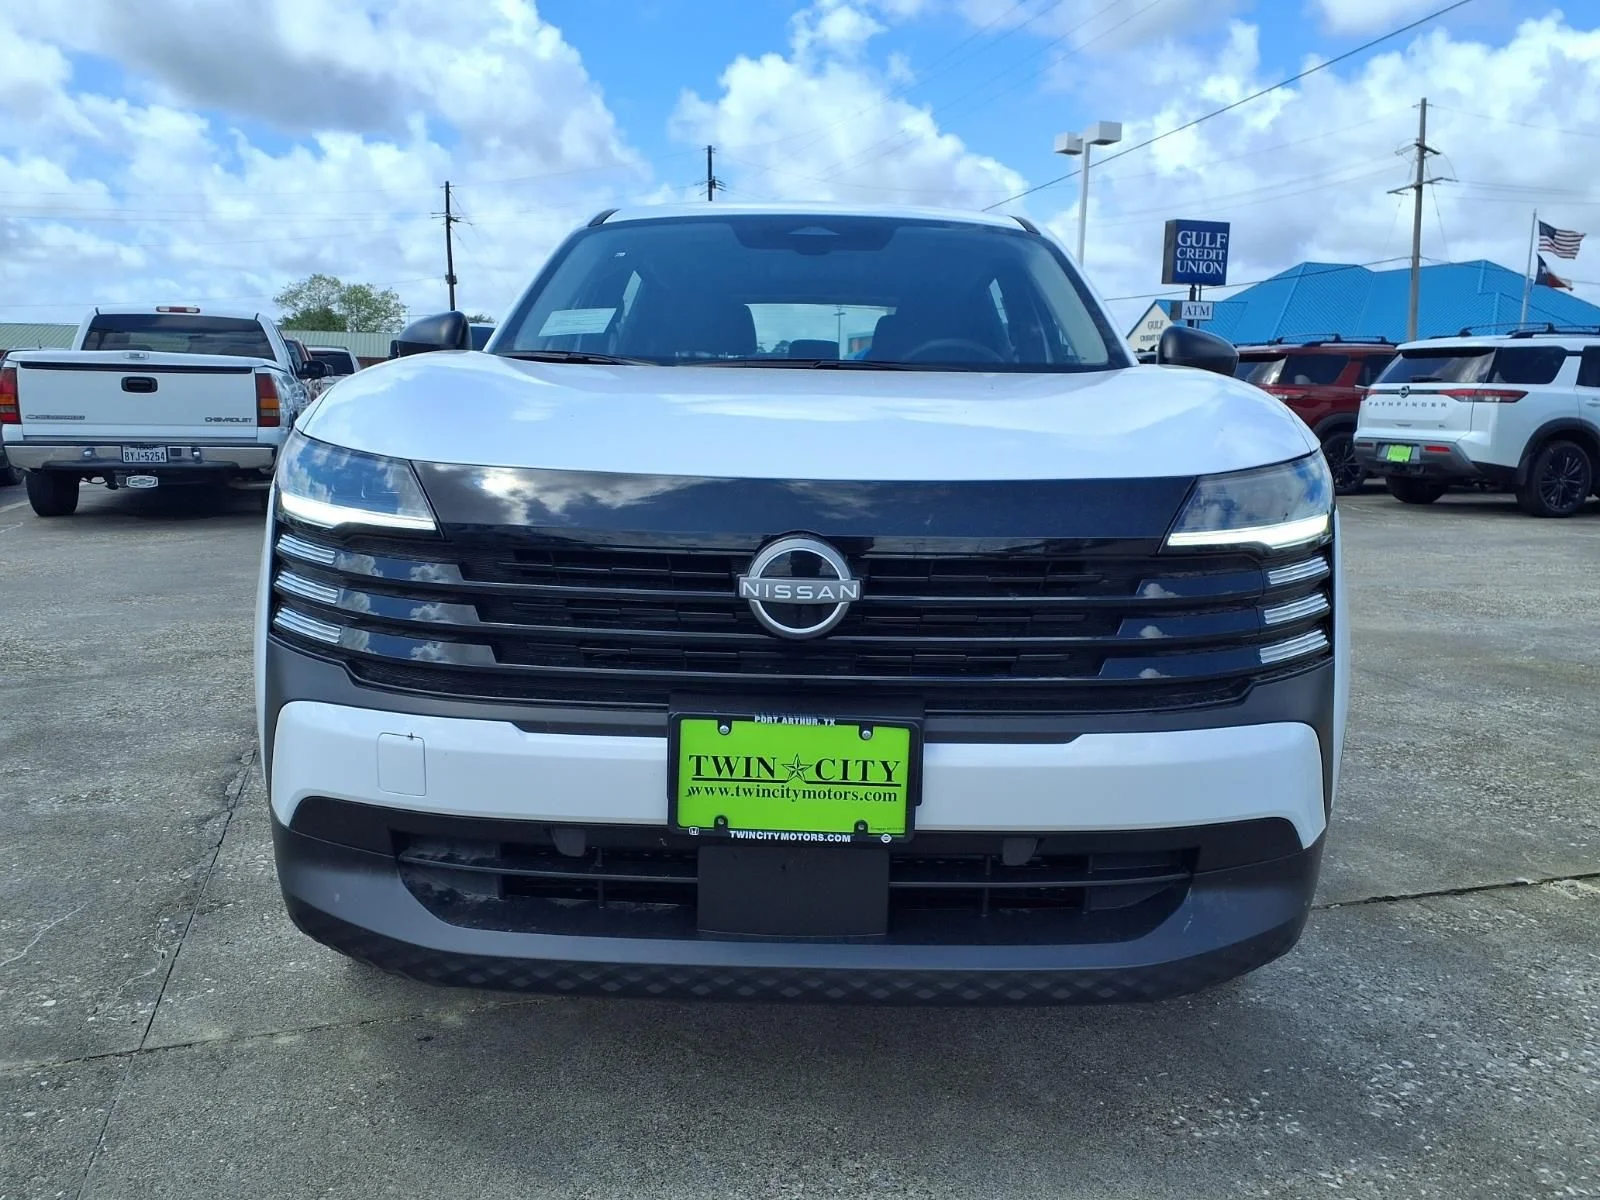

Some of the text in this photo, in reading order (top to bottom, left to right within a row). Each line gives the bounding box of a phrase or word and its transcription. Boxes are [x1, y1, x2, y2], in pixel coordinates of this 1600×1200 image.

[1177, 231, 1228, 249] GULF
[1176, 247, 1226, 261] CREDIT
[1176, 261, 1224, 275] UNION
[1184, 306, 1210, 317] ATM
[742, 581, 857, 600] NISSAN
[754, 715, 779, 725] PORT
[823, 718, 836, 726] TX
[688, 754, 901, 783] TWIN CITY
[685, 784, 898, 802] www.twincitymotors.com
[729, 830, 851, 843] TWINCITYMOTORS.COM
